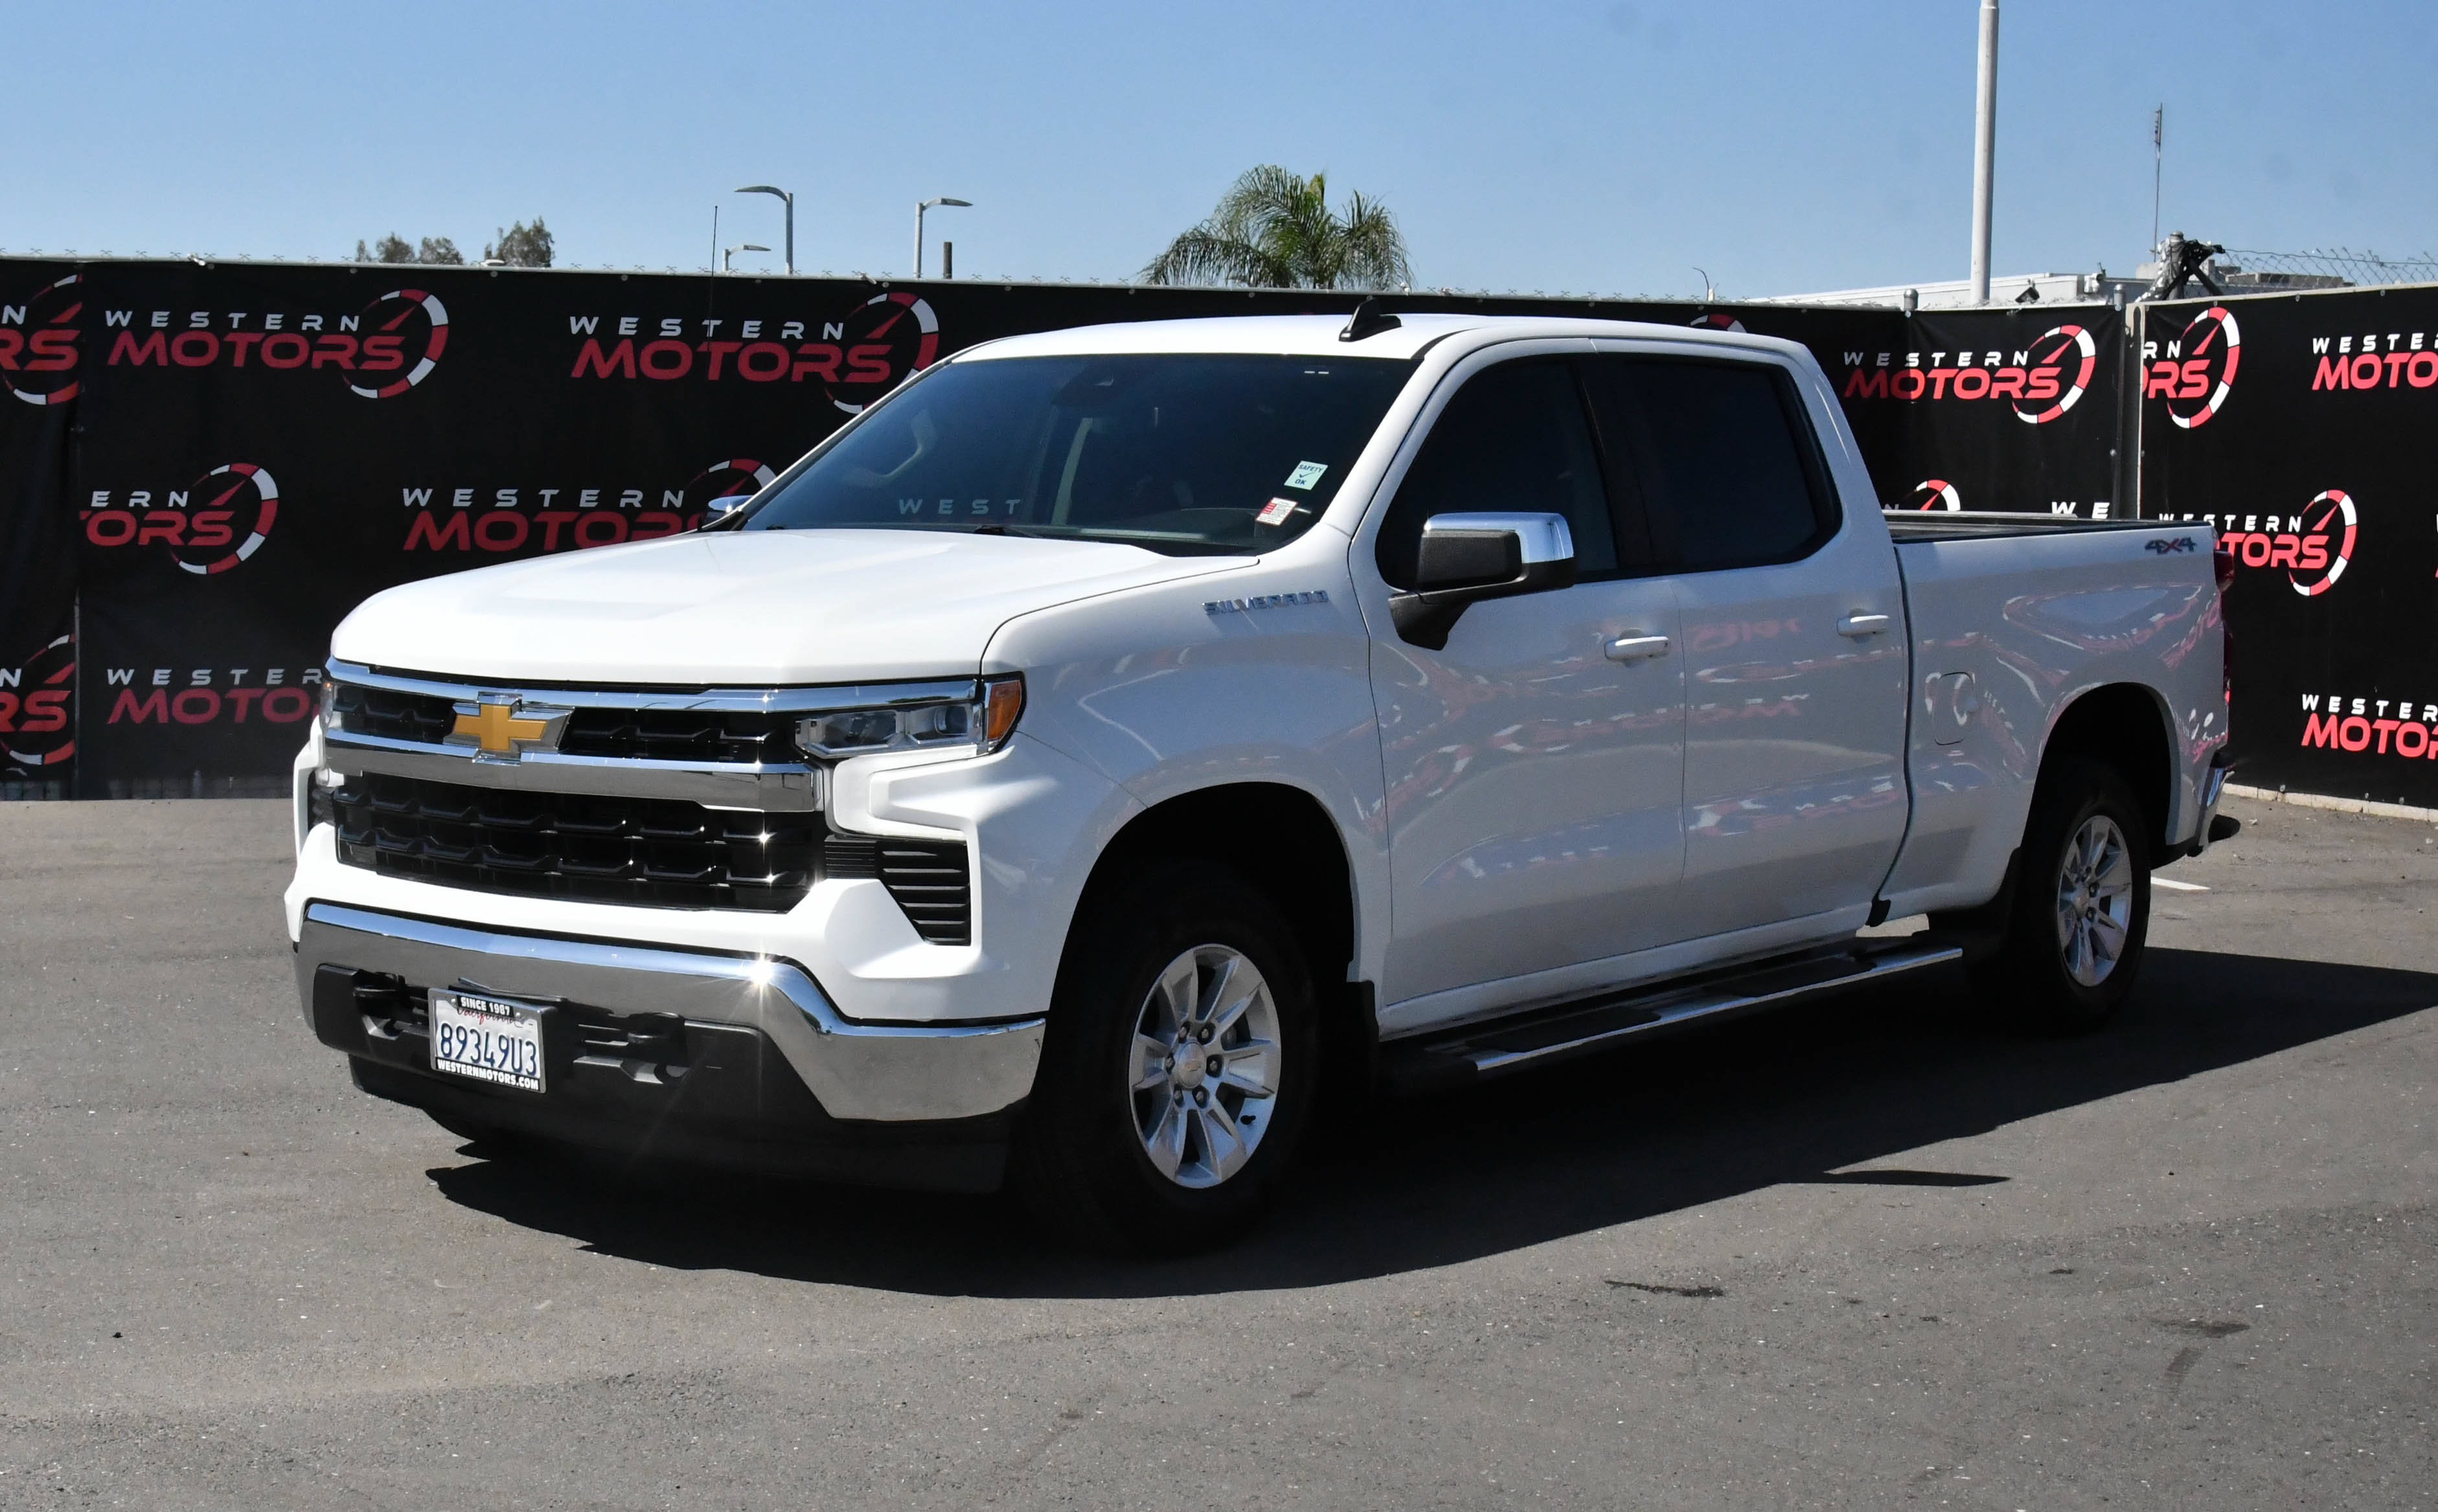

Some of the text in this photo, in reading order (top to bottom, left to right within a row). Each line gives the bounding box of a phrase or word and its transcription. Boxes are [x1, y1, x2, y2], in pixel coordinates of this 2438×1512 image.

[106, 310, 360, 331] WESTERN
[569, 316, 845, 339] WESTERN
[107, 329, 405, 370] MOTORS
[2312, 332, 2438, 354] WESTE
[570, 338, 893, 383] MOTORS
[1843, 350, 2029, 367] WESTERN
[1844, 367, 2062, 400] MOTORS
[1298, 464, 1323, 473] SAFETY
[402, 488, 685, 508] WESTERN
[402, 510, 699, 551] MOTOR
[2215, 532, 2330, 569] TORS
[1203, 590, 1328, 616] SILVERADO
[106, 687, 320, 725] MOTO
[461, 996, 510, 1016] SINCE 1987
[440, 1022, 537, 1076] 89349U3
[437, 1058, 539, 1091] WESTERNMOTORS.COM
